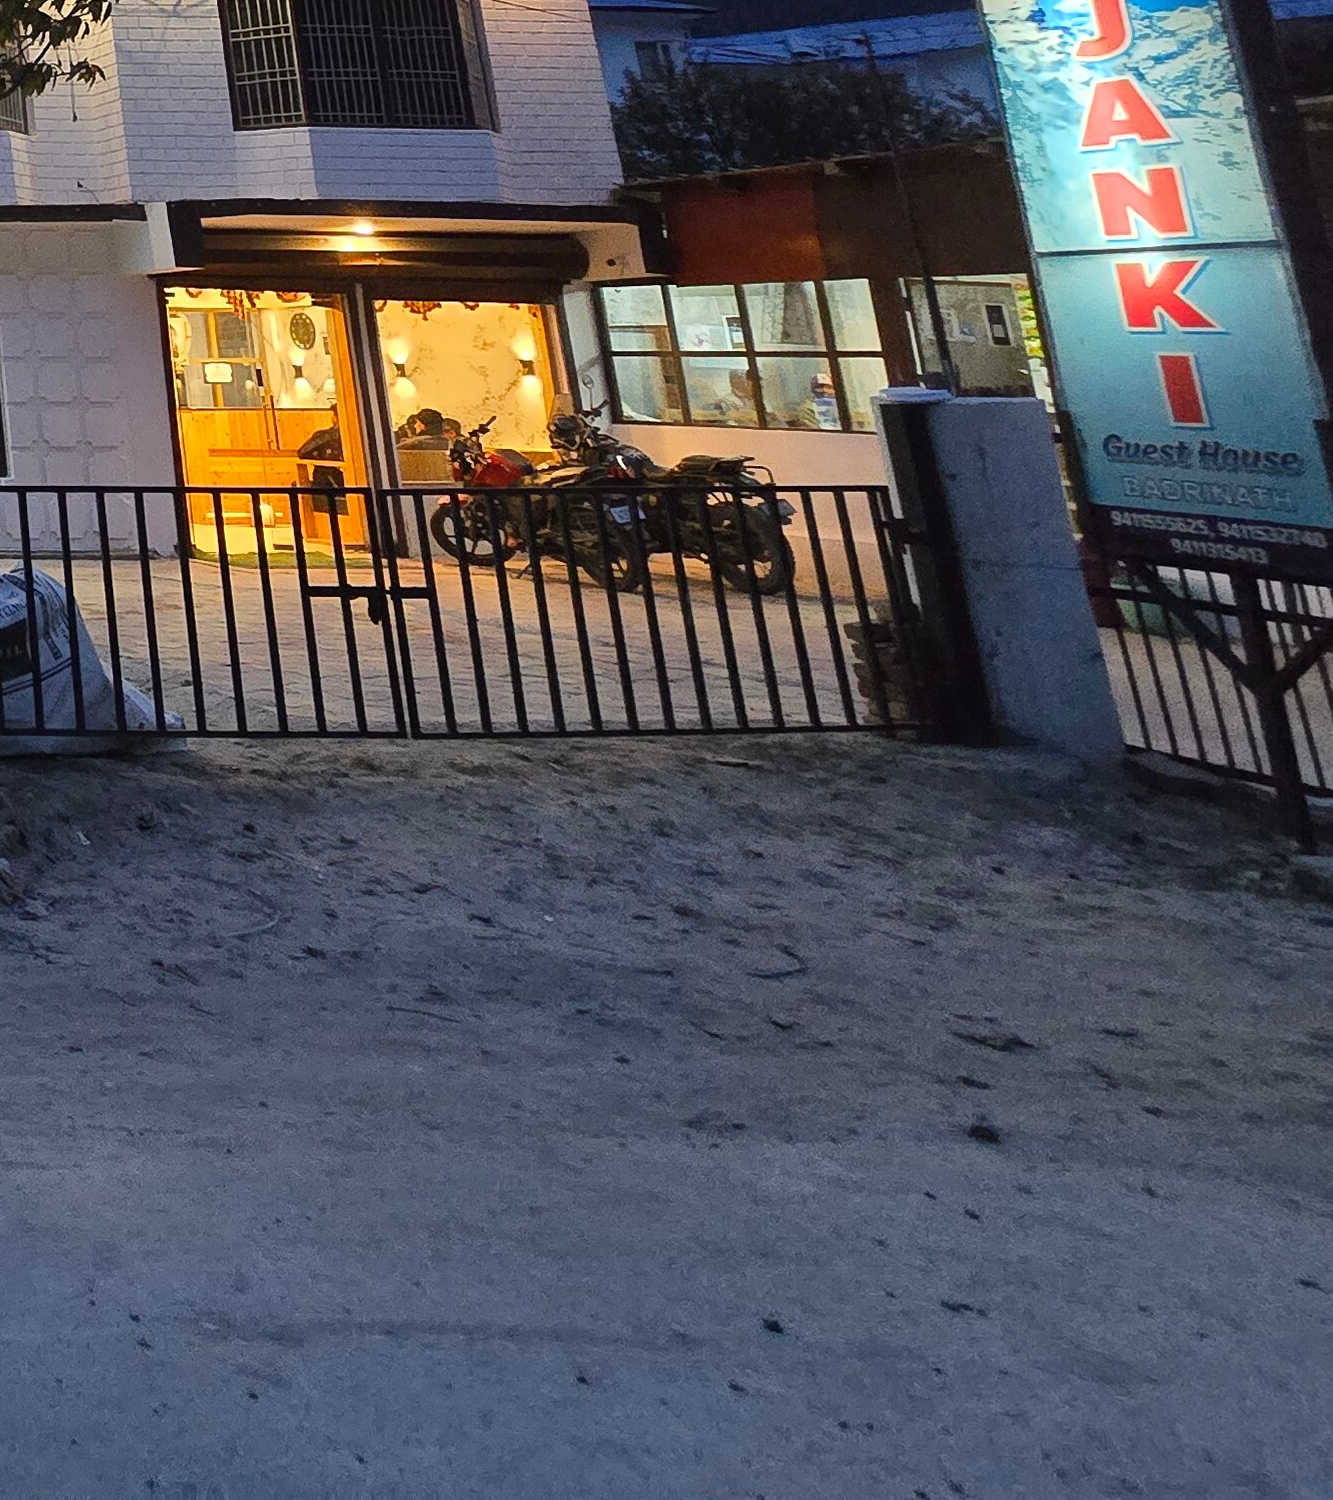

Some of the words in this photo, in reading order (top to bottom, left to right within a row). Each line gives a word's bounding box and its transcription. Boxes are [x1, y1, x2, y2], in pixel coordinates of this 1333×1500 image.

[1103, 434, 1191, 467] Guest
[1199, 440, 1304, 474] House
[1124, 476, 1296, 509] BADRINATH
